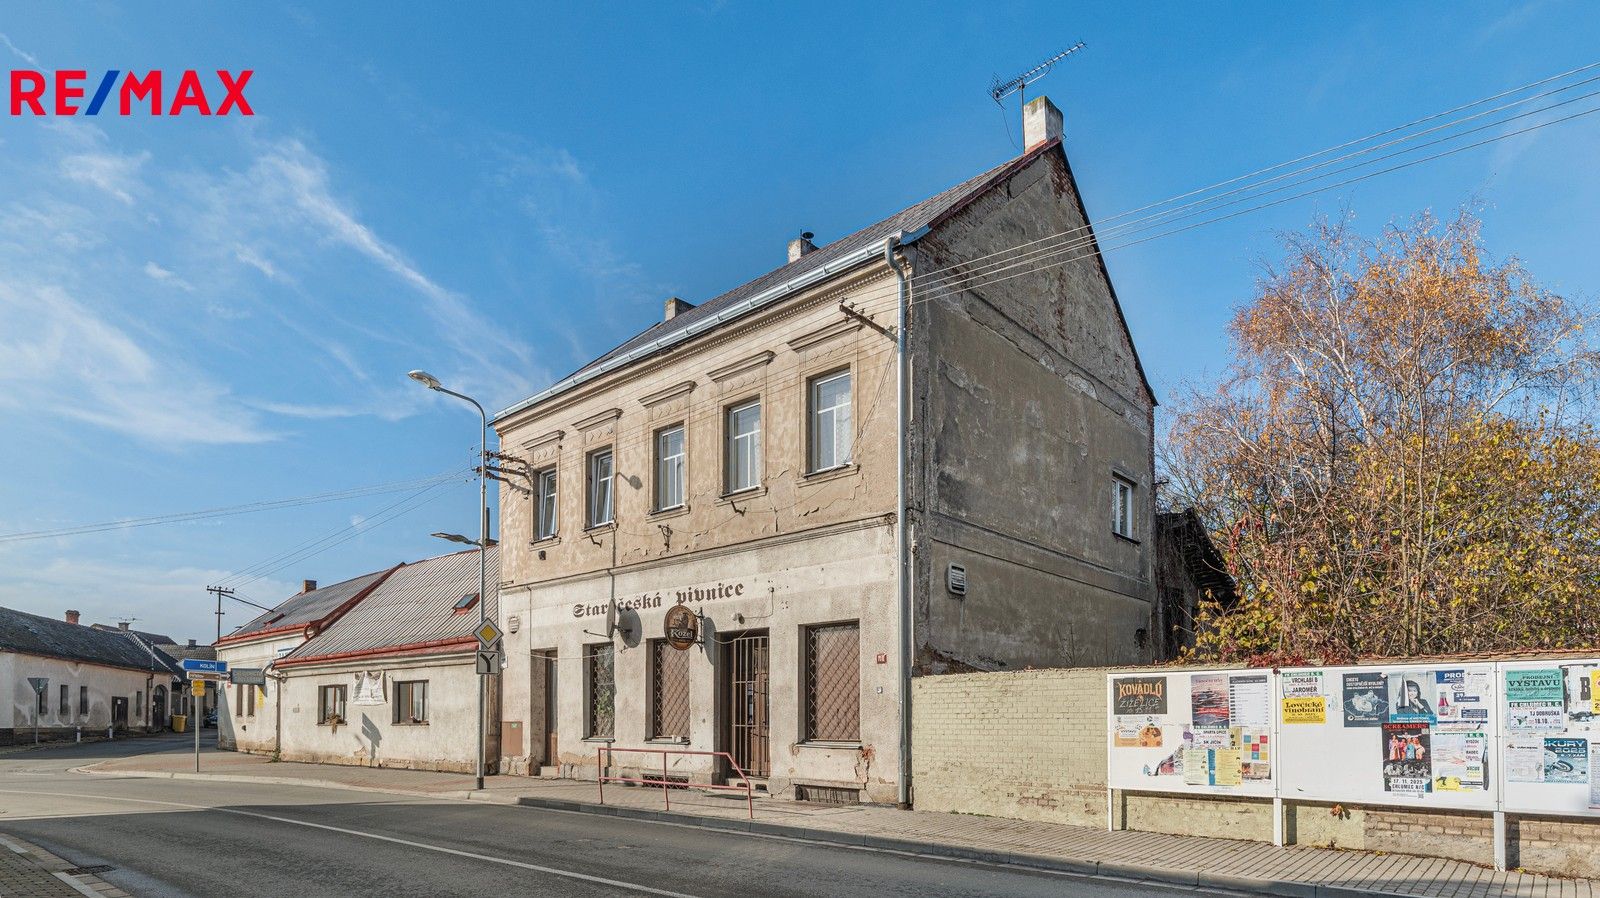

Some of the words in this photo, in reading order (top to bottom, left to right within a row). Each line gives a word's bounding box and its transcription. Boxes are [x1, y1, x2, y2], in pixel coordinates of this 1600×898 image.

[573, 592, 662, 618] Starčeská
[676, 583, 744, 606] pivnice
[670, 628, 693, 639] Kozel
